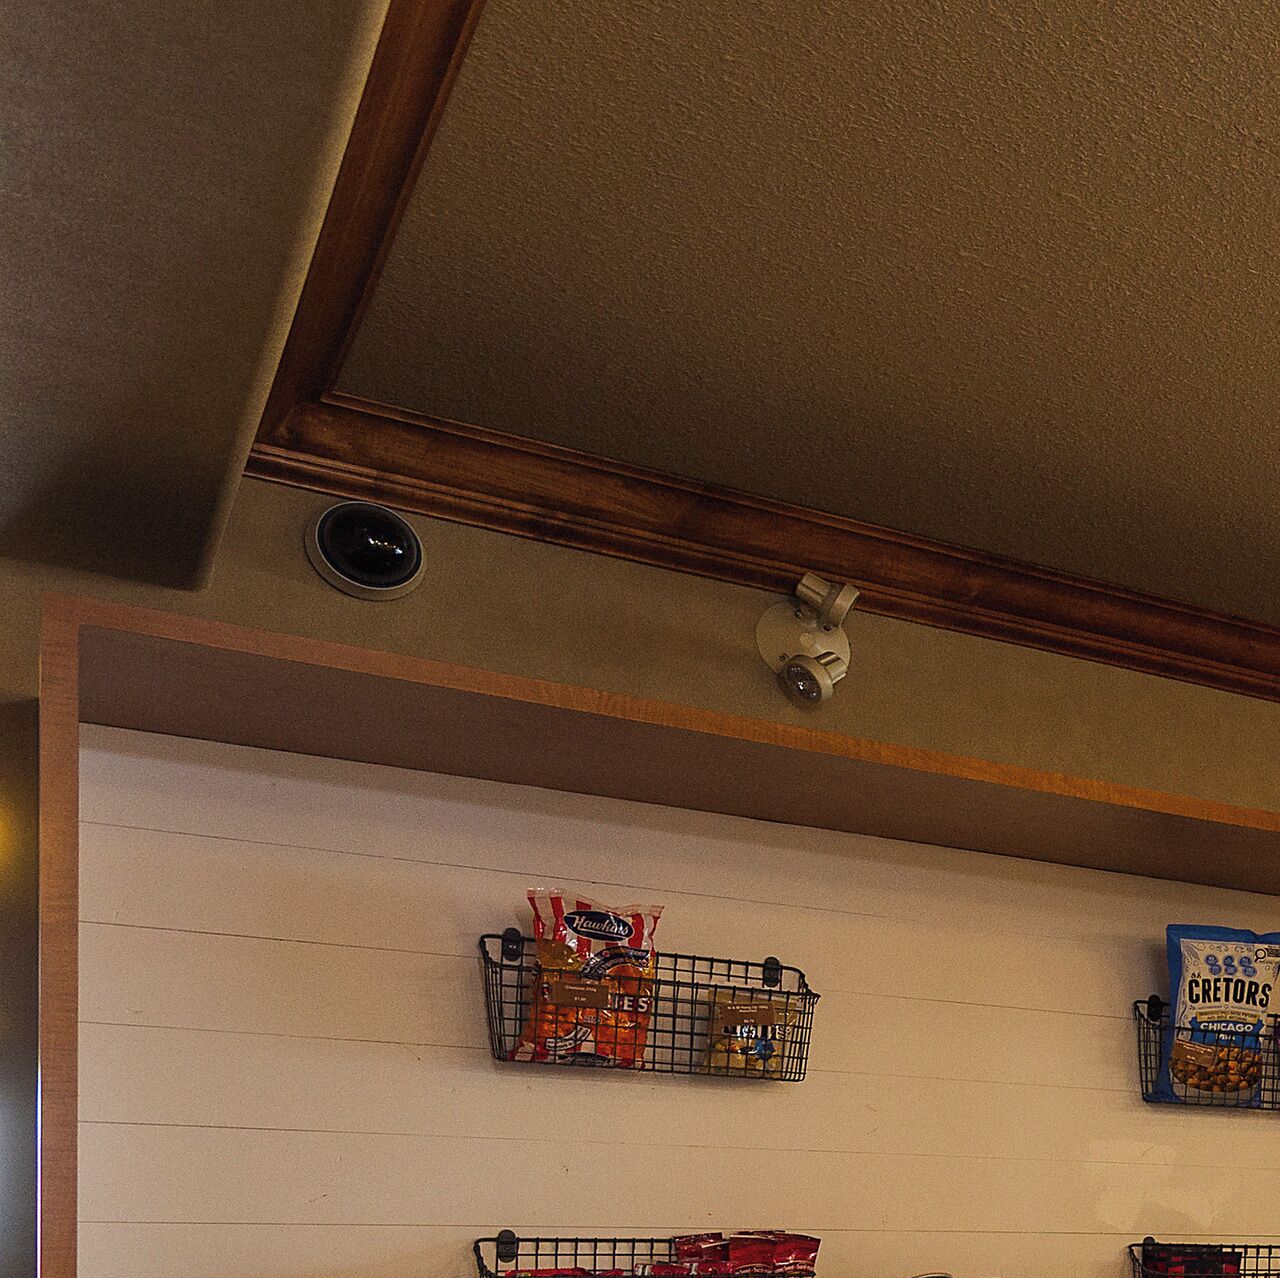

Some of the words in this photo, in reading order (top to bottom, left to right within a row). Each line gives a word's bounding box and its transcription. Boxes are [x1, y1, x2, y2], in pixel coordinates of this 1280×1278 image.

[573, 915, 629, 936] Hawkins
[1188, 977, 1272, 1008] CRETORS
[1200, 1022, 1254, 1032] CHICAGO
